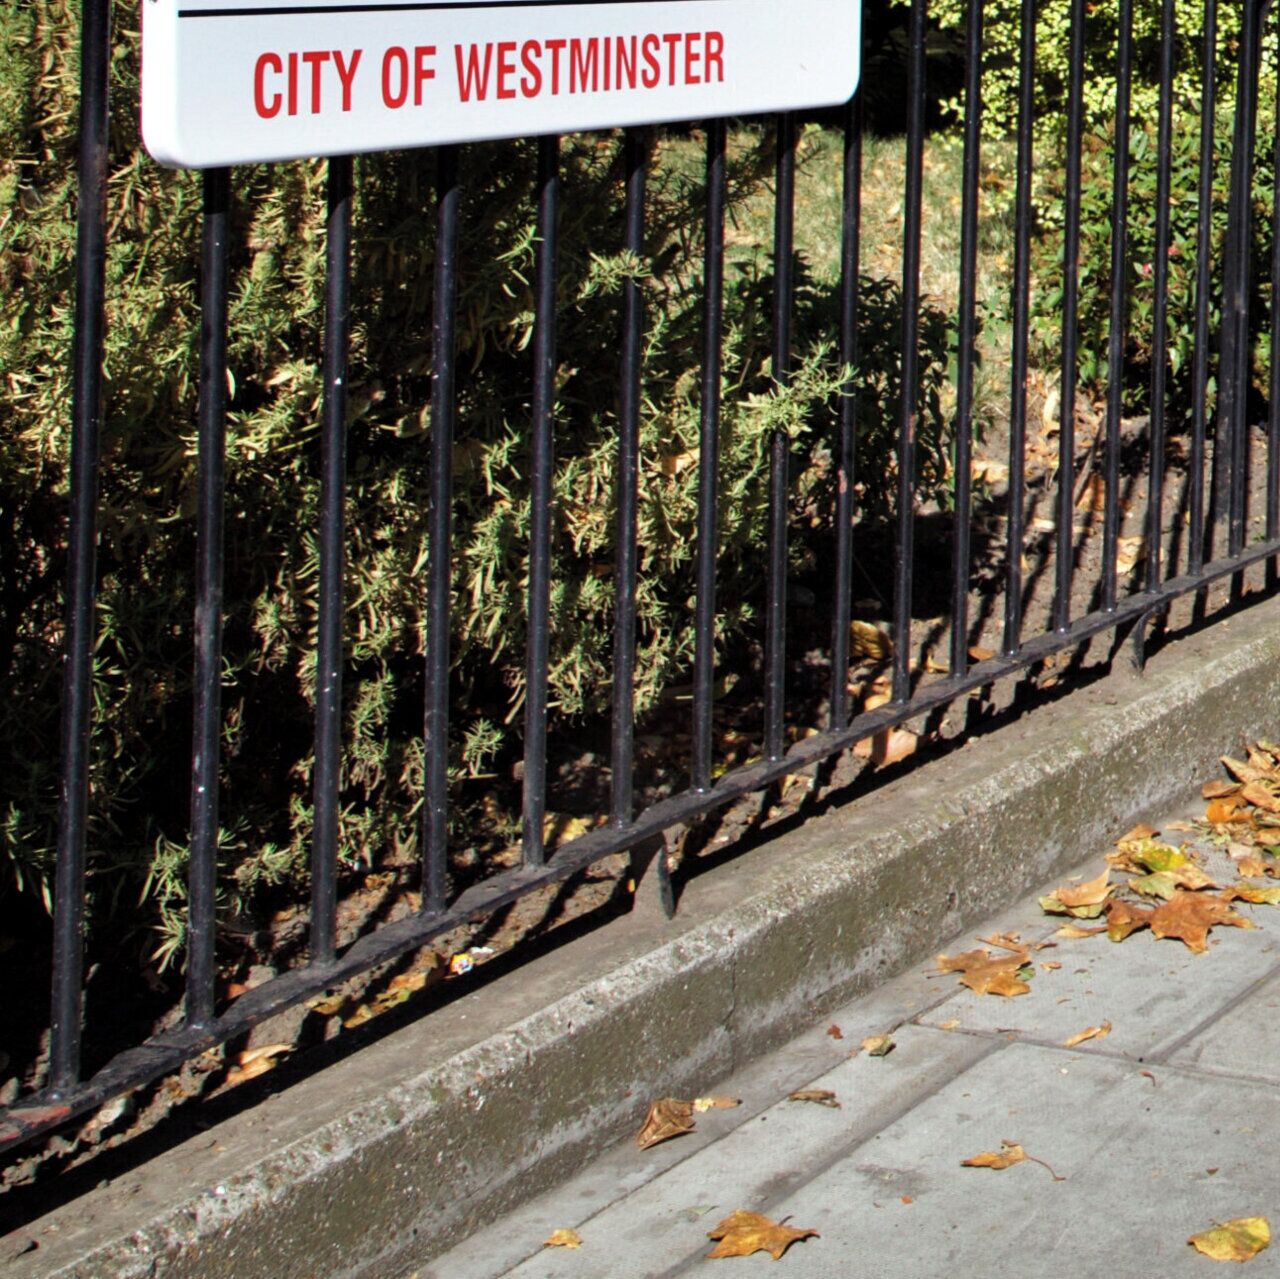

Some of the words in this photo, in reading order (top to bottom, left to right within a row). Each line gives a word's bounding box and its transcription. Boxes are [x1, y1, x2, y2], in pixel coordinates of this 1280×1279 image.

[253, 49, 362, 119] CITY
[381, 45, 437, 109] OF
[455, 31, 725, 101] WESTMINSTER
